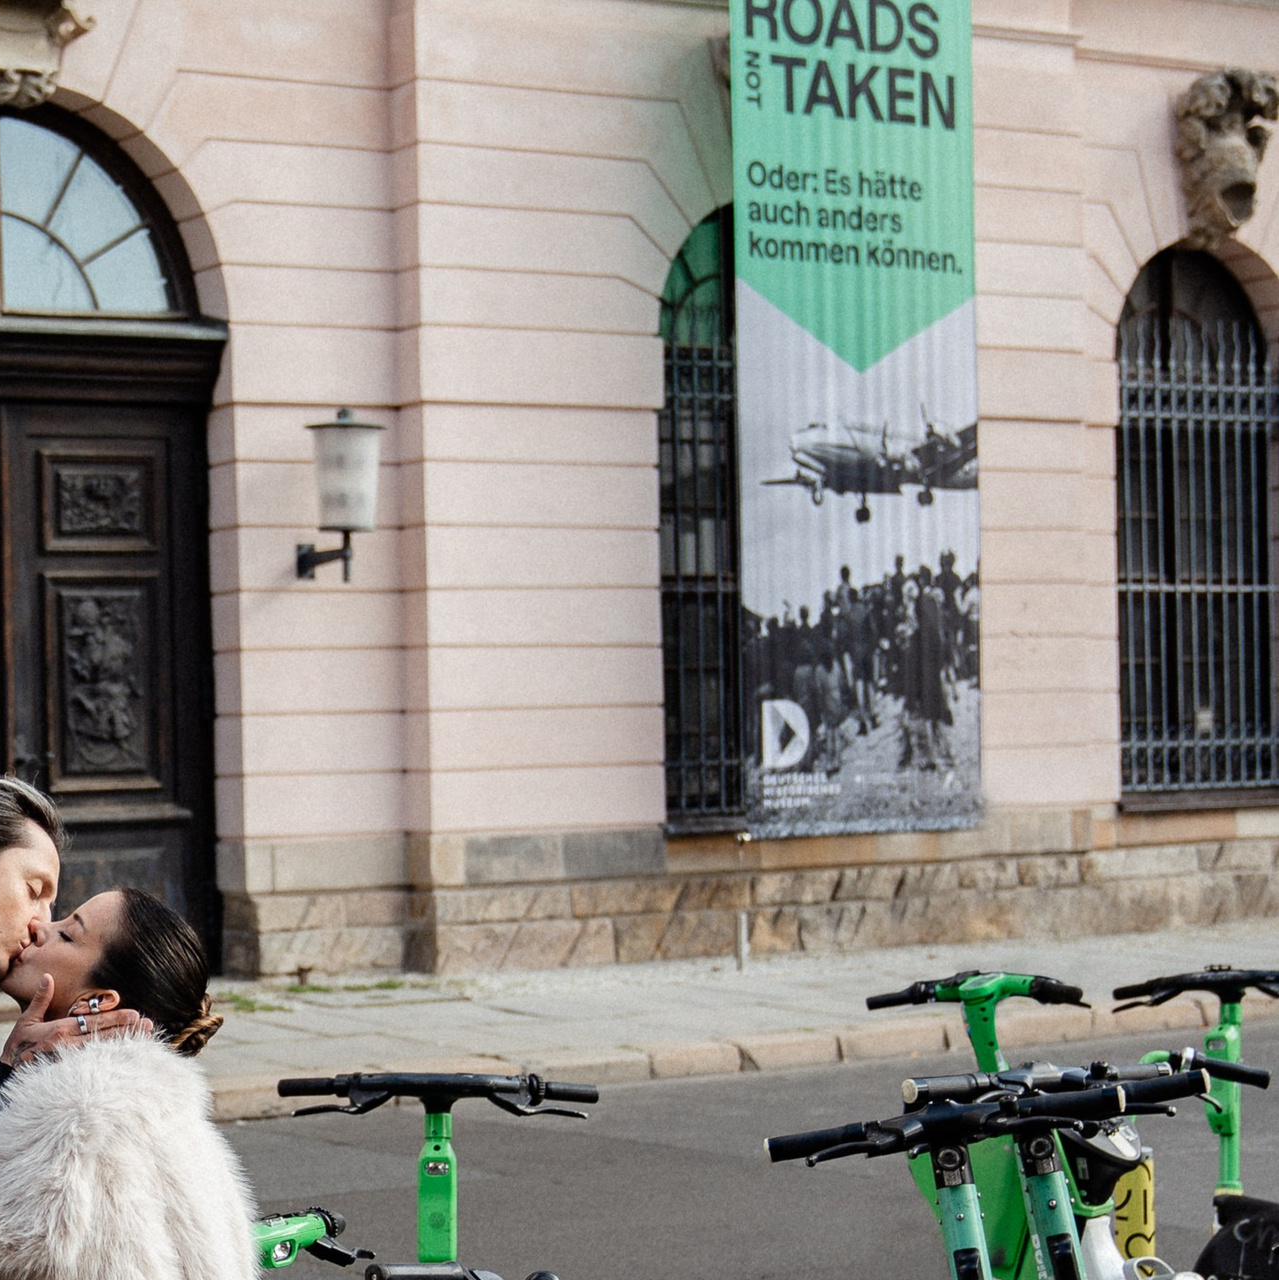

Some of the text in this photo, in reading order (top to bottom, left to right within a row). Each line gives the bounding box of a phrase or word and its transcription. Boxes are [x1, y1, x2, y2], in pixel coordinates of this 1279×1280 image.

[744, 0, 940, 60] ROADS
[745, 50, 956, 130] NOT TAKEN
[747, 160, 922, 201] Oder: Es hätte
[748, 201, 902, 234] auch anders
[748, 230, 963, 275] kommen können.
